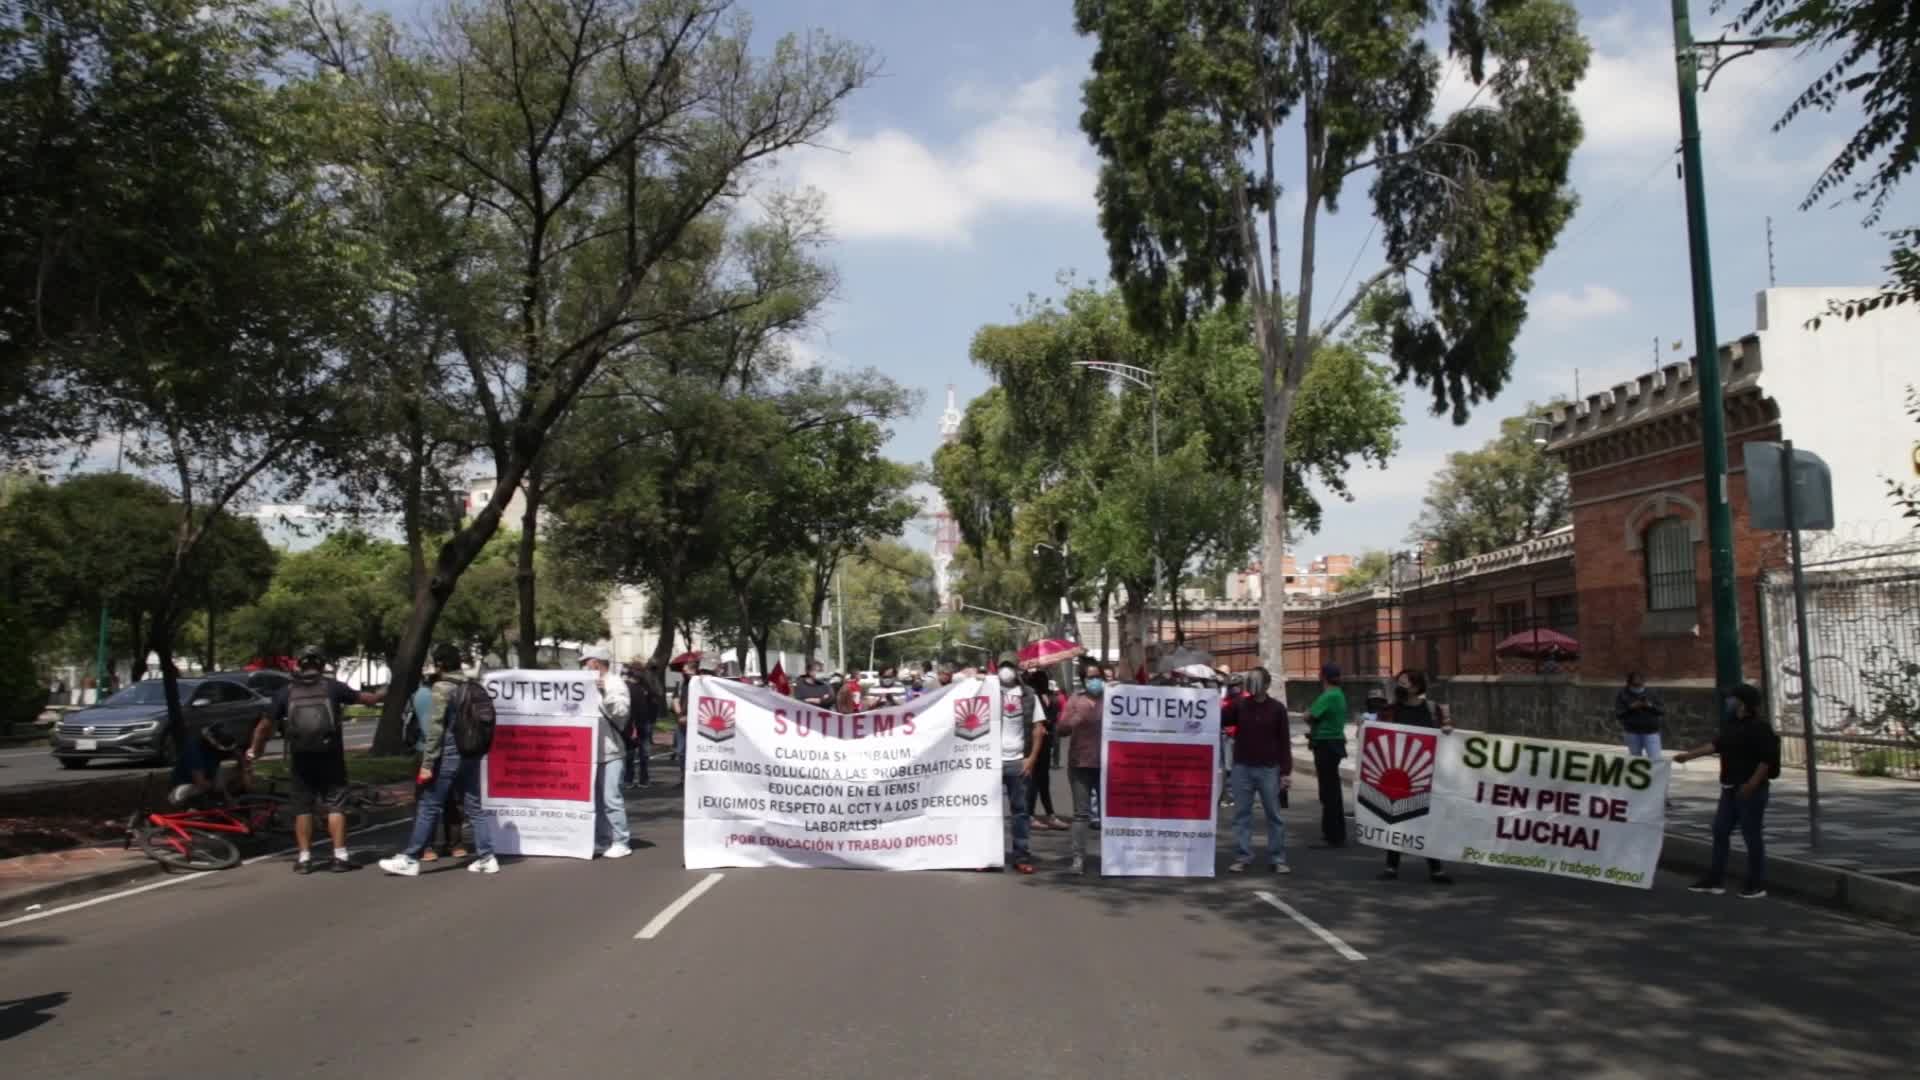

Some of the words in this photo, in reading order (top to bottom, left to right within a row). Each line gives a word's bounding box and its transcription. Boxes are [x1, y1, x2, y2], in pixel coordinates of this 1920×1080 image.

[487, 680, 585, 702] SUTIEMS
[1110, 695, 1208, 719] SUTIEMS
[774, 709, 916, 740] SUTIEMS
[775, 747, 829, 760] CLAUDIA
[1462, 737, 1652, 791] SUTIEMS
[694, 759, 761, 776] ¡EXIGIMOS
[833, 768, 842, 780] A
[846, 767, 867, 780] LAS
[976, 757, 992, 770] DE
[847, 785, 864, 798] EN
[867, 785, 882, 797] EL
[885, 782, 920, 797] IEMS!
[698, 795, 766, 811] ¡EXIGIMOS
[770, 799, 825, 814] RESPETO
[829, 802, 844, 816] AL
[847, 802, 872, 815] CCT
[873, 802, 882, 814] Y
[884, 801, 893, 813] A
[895, 799, 919, 812] LOS
[921, 794, 989, 809] DERECHOS
[1491, 784, 1530, 811] EN
[1536, 789, 1582, 817] PIE
[1588, 796, 1629, 823] DE
[725, 834, 755, 849] ¡POR
[837, 840, 846, 851] Y
[848, 837, 902, 852] TRABAJO
[905, 833, 959, 849] DIGNOS!
[1355, 822, 1425, 850] SUTIEMS
